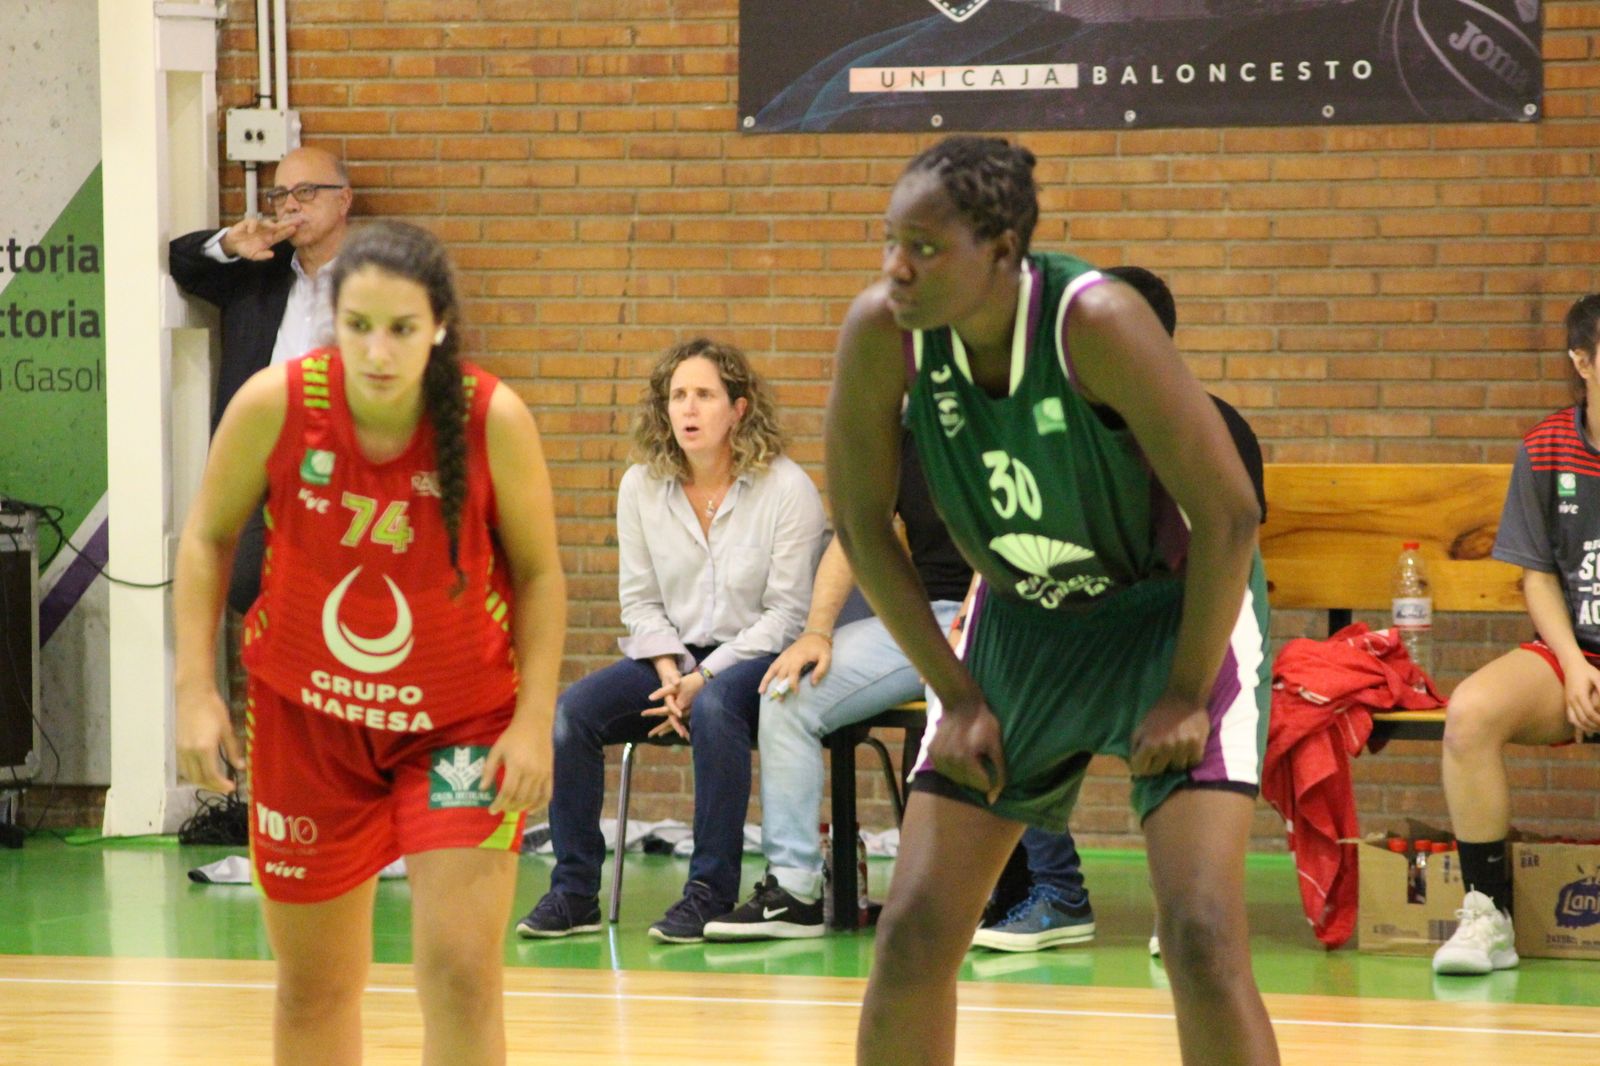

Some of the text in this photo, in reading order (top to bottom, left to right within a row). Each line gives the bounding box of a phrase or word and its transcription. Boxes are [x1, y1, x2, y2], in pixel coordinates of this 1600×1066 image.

[881, 60, 1372, 89] UNICAJA BALONCESTO
[0, 235, 99, 273] toria
[0, 300, 100, 338] toria
[15, 359, 100, 392] Gasol
[982, 450, 1042, 520] 30
[340, 491, 414, 553] 74
[310, 670, 423, 705] GRUPO
[301, 688, 434, 732] HAFESA
